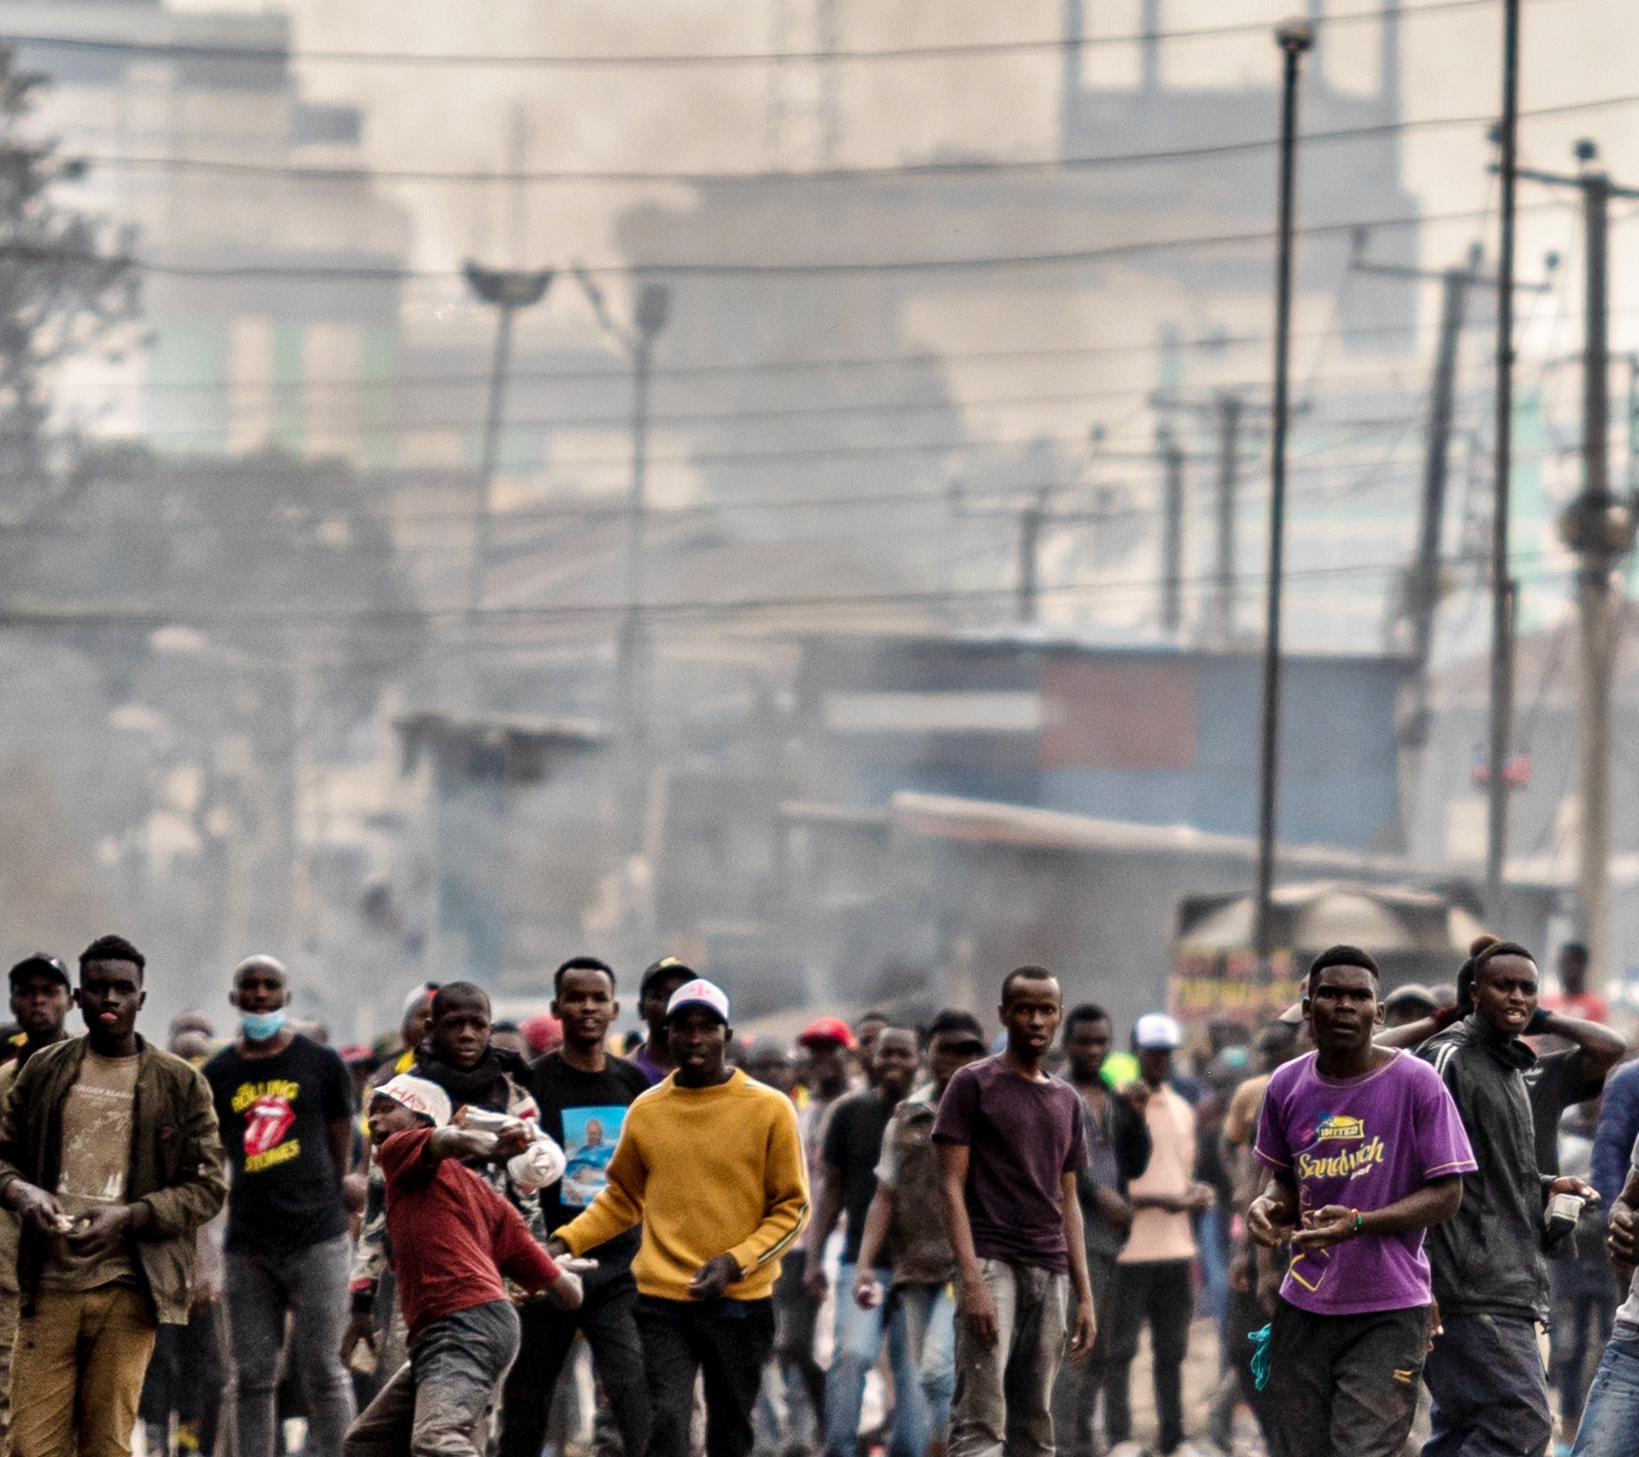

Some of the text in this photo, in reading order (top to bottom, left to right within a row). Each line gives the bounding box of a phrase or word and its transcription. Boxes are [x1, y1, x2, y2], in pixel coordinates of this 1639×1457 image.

[231, 1080, 299, 1112] ROLLING
[245, 1140, 300, 1172] STONES
[1299, 1136, 1384, 1180] Sandwich
